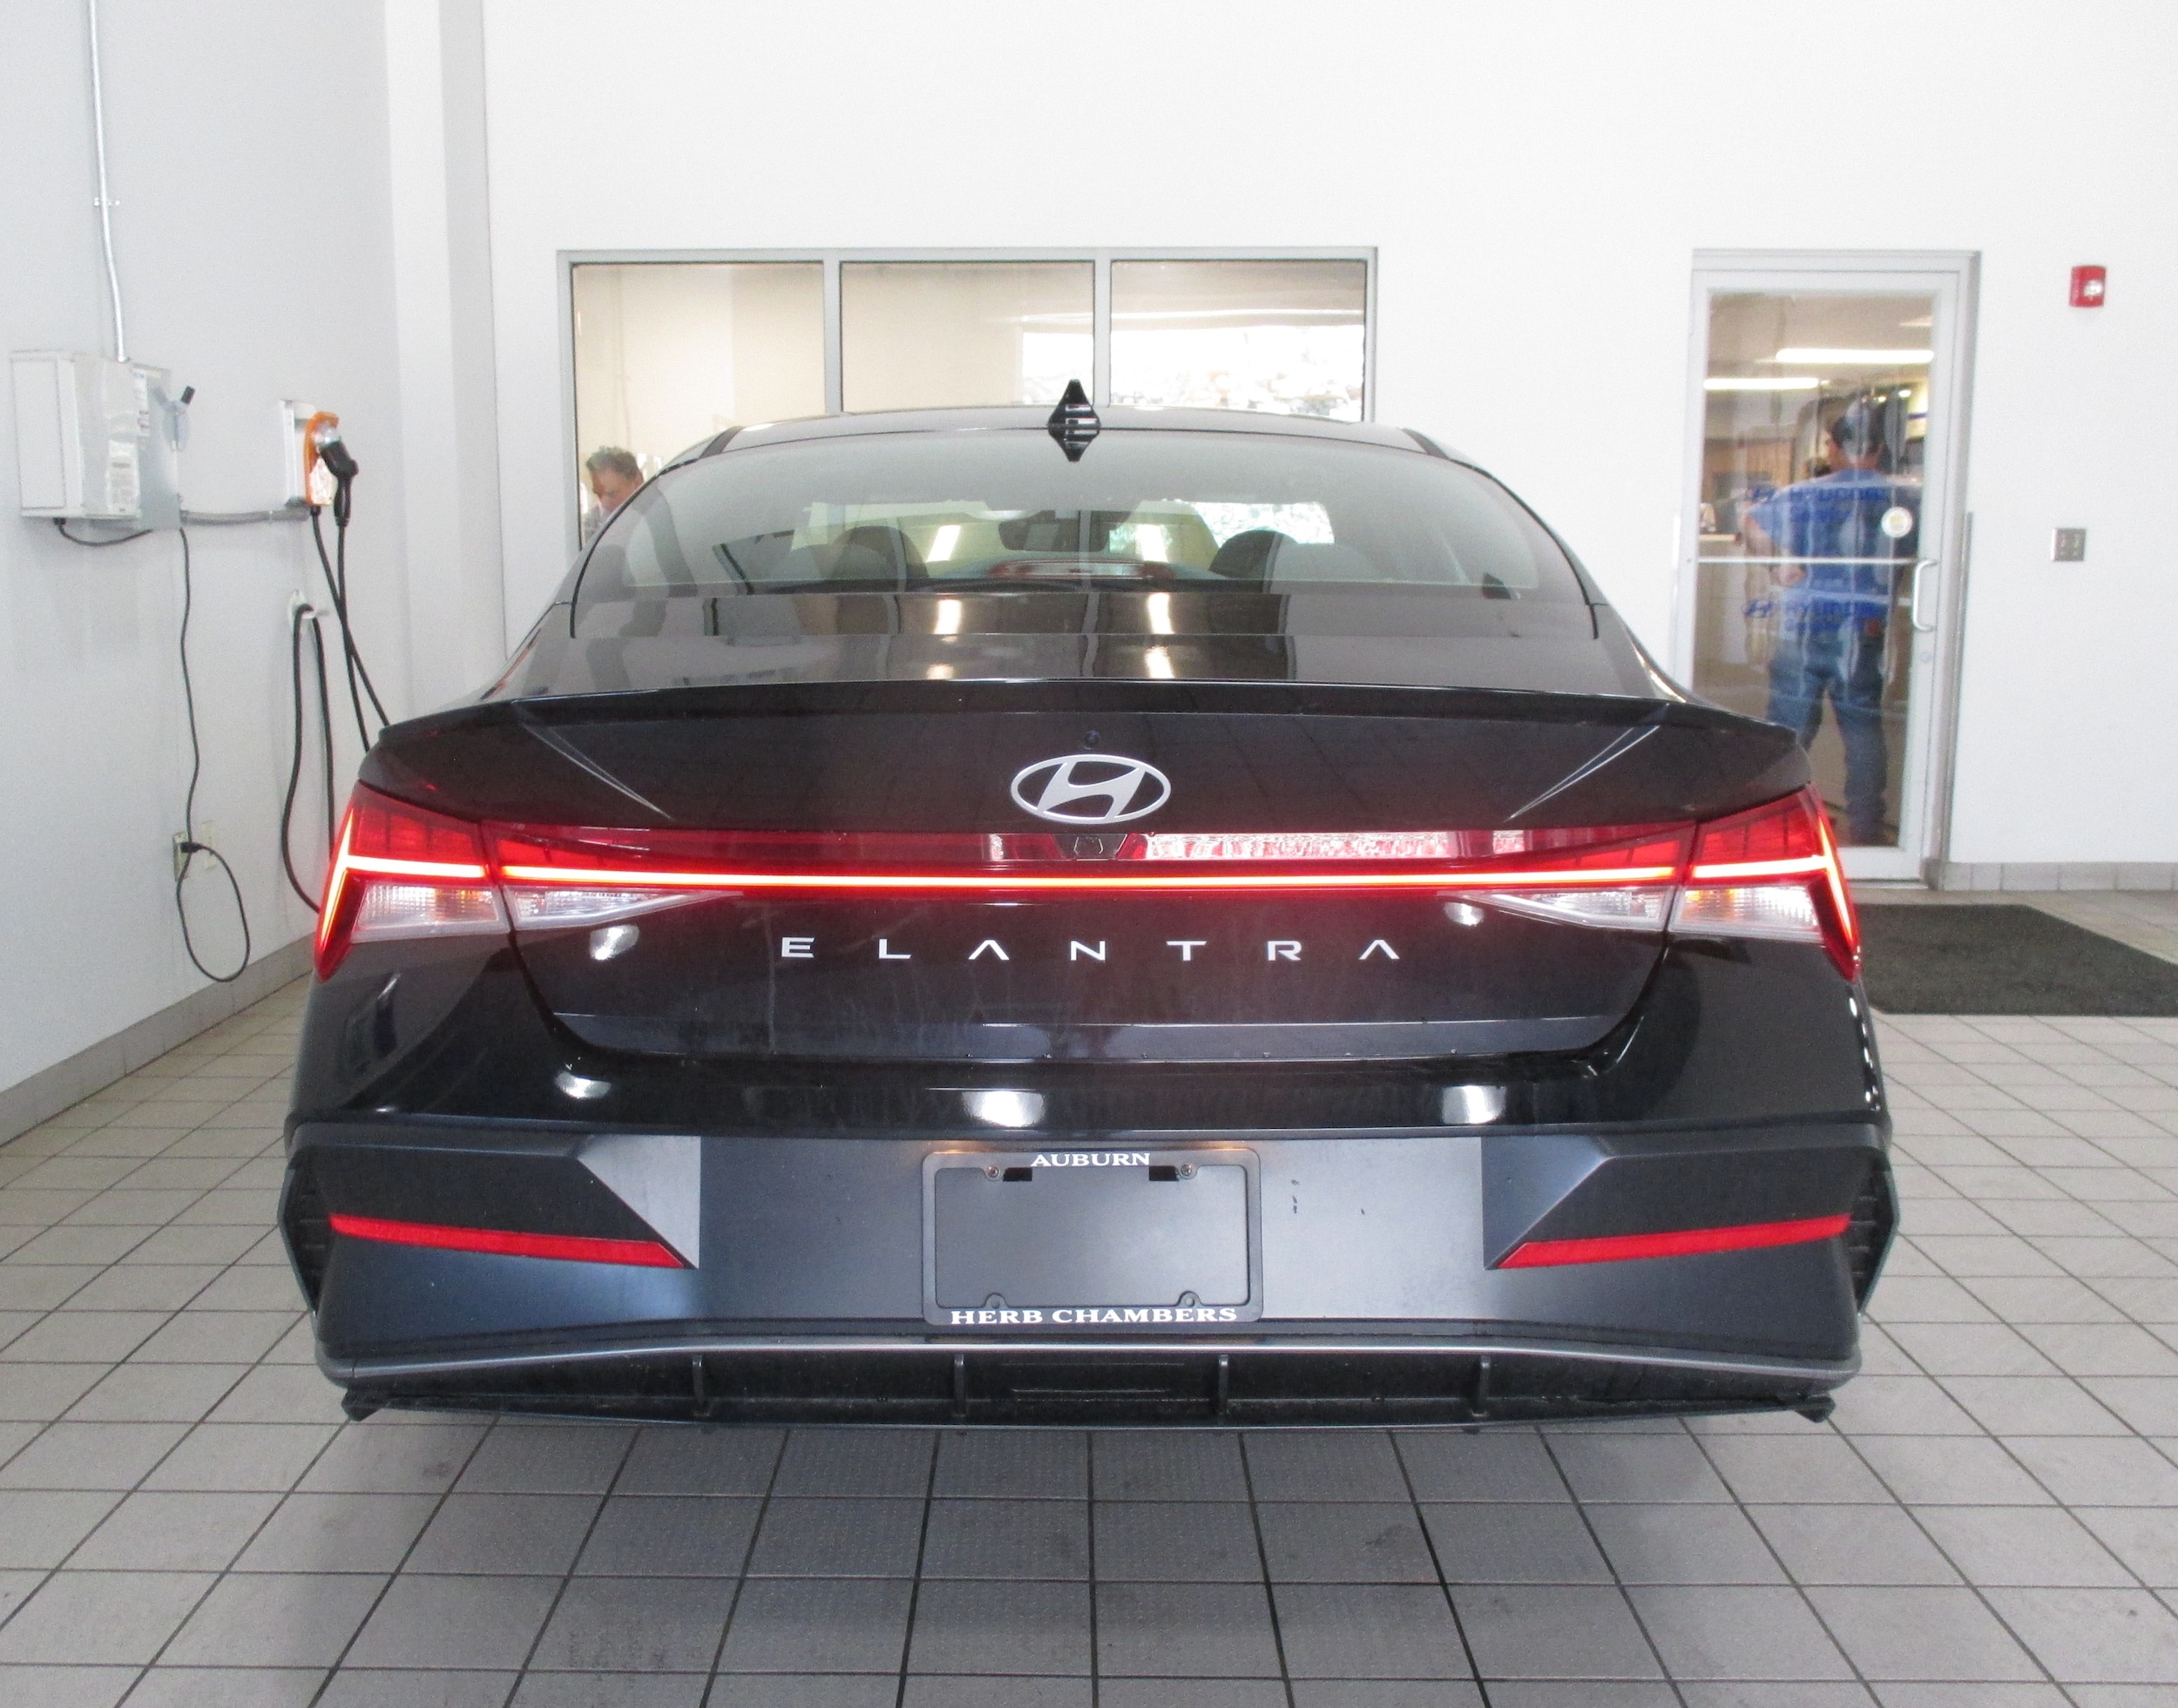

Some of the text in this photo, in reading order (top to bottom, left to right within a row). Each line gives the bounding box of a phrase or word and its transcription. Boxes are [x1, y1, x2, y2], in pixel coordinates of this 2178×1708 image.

[781, 936, 1400, 962] ELANTRA
[1030, 1152, 1151, 1167] AUBURN
[950, 1307, 1238, 1325] HERB CHAMBERS
